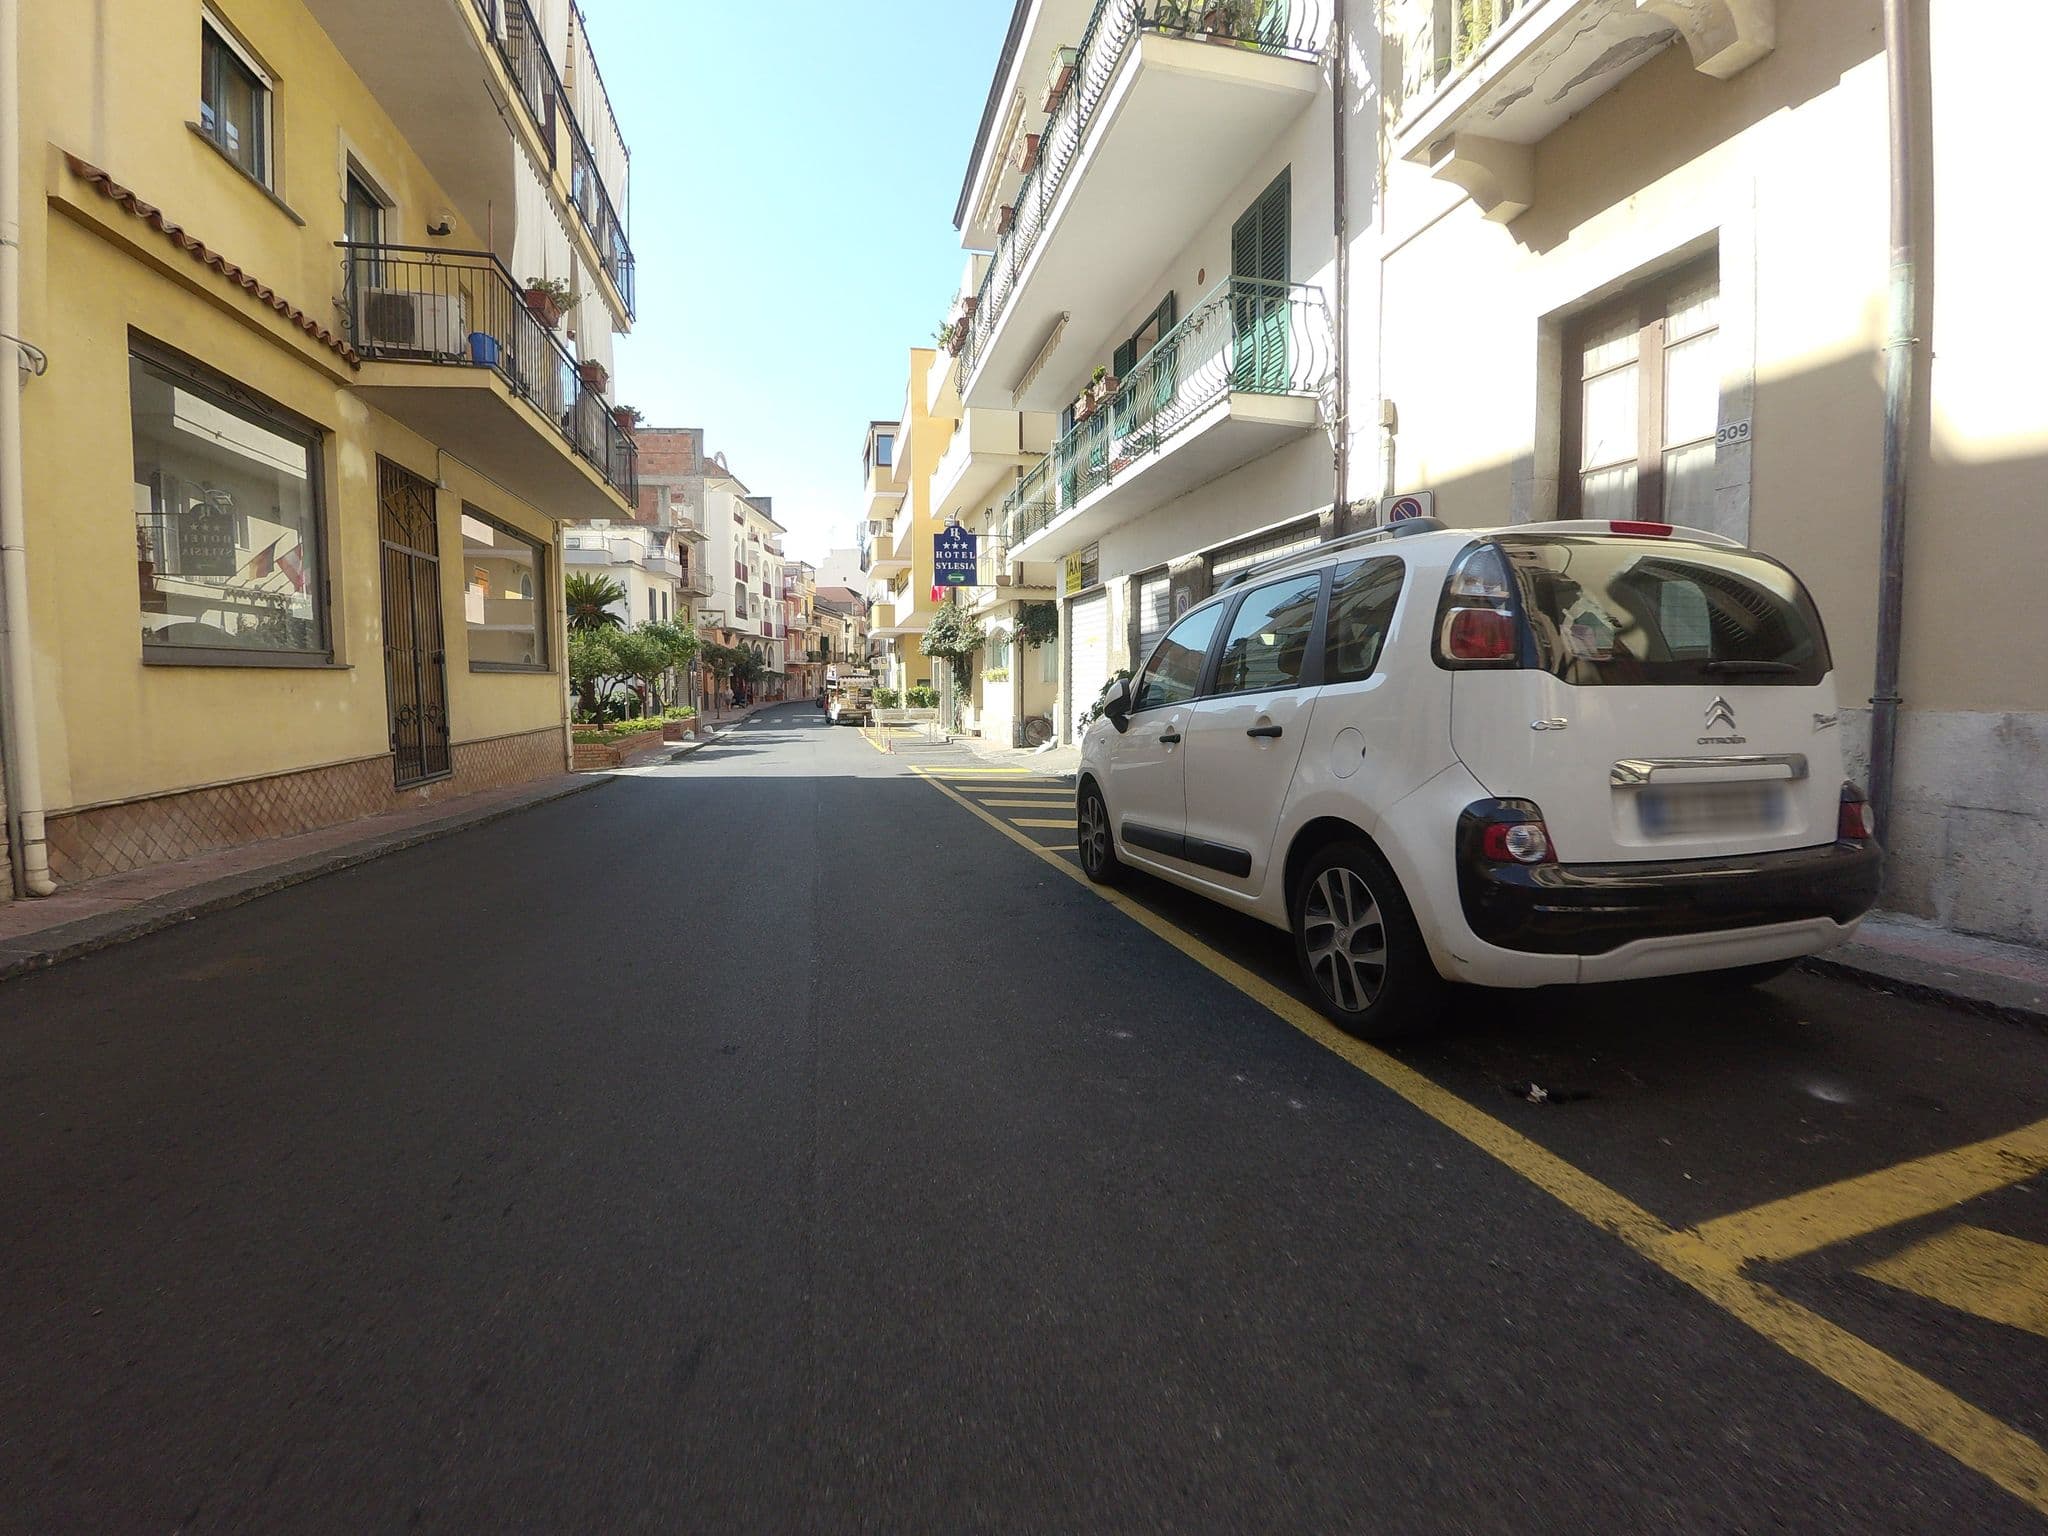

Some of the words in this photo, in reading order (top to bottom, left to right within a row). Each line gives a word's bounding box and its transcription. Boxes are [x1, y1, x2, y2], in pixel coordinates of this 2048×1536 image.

[1718, 423, 1748, 442] 309
[935, 551, 976, 559] HOTEL
[935, 562, 975, 570] SYLESIA
[1065, 554, 1081, 578] TAXI
